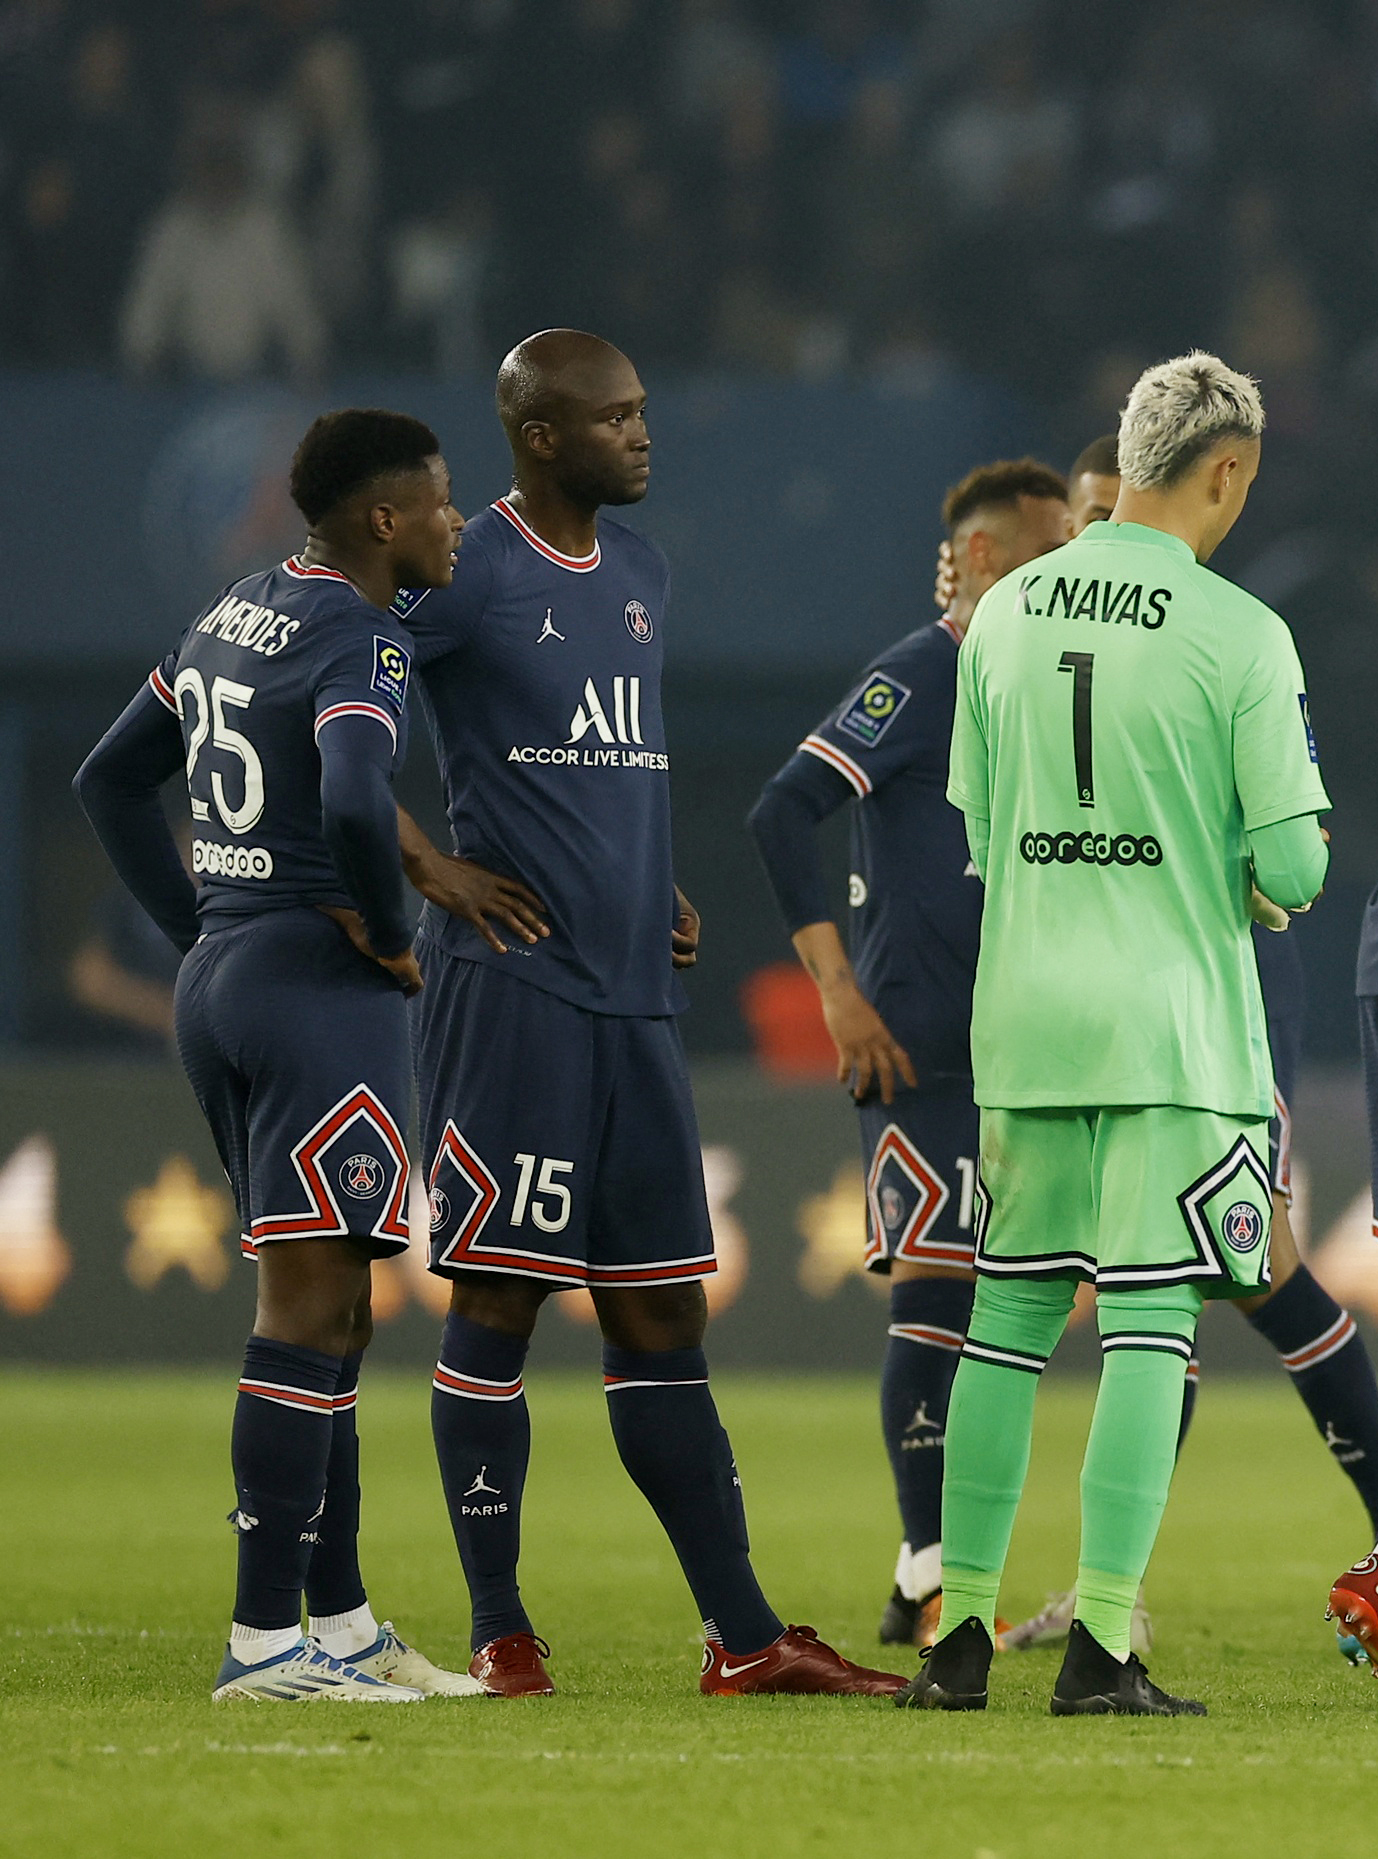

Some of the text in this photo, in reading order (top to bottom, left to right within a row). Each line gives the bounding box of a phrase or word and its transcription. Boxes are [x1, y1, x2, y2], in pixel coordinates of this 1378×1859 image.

[1013, 574, 1173, 630] K.NAVAS
[1056, 651, 1095, 809] 1
[173, 667, 264, 836] 25
[507, 745, 580, 767] ACCOR
[583, 749, 620, 767] LIVE
[1019, 831, 1164, 867] ooredoo
[347, 1156, 378, 1170] PARIS
[509, 1152, 575, 1234] 15
[1230, 1205, 1256, 1220] PARIS
[461, 1502, 509, 1516] PARIS
